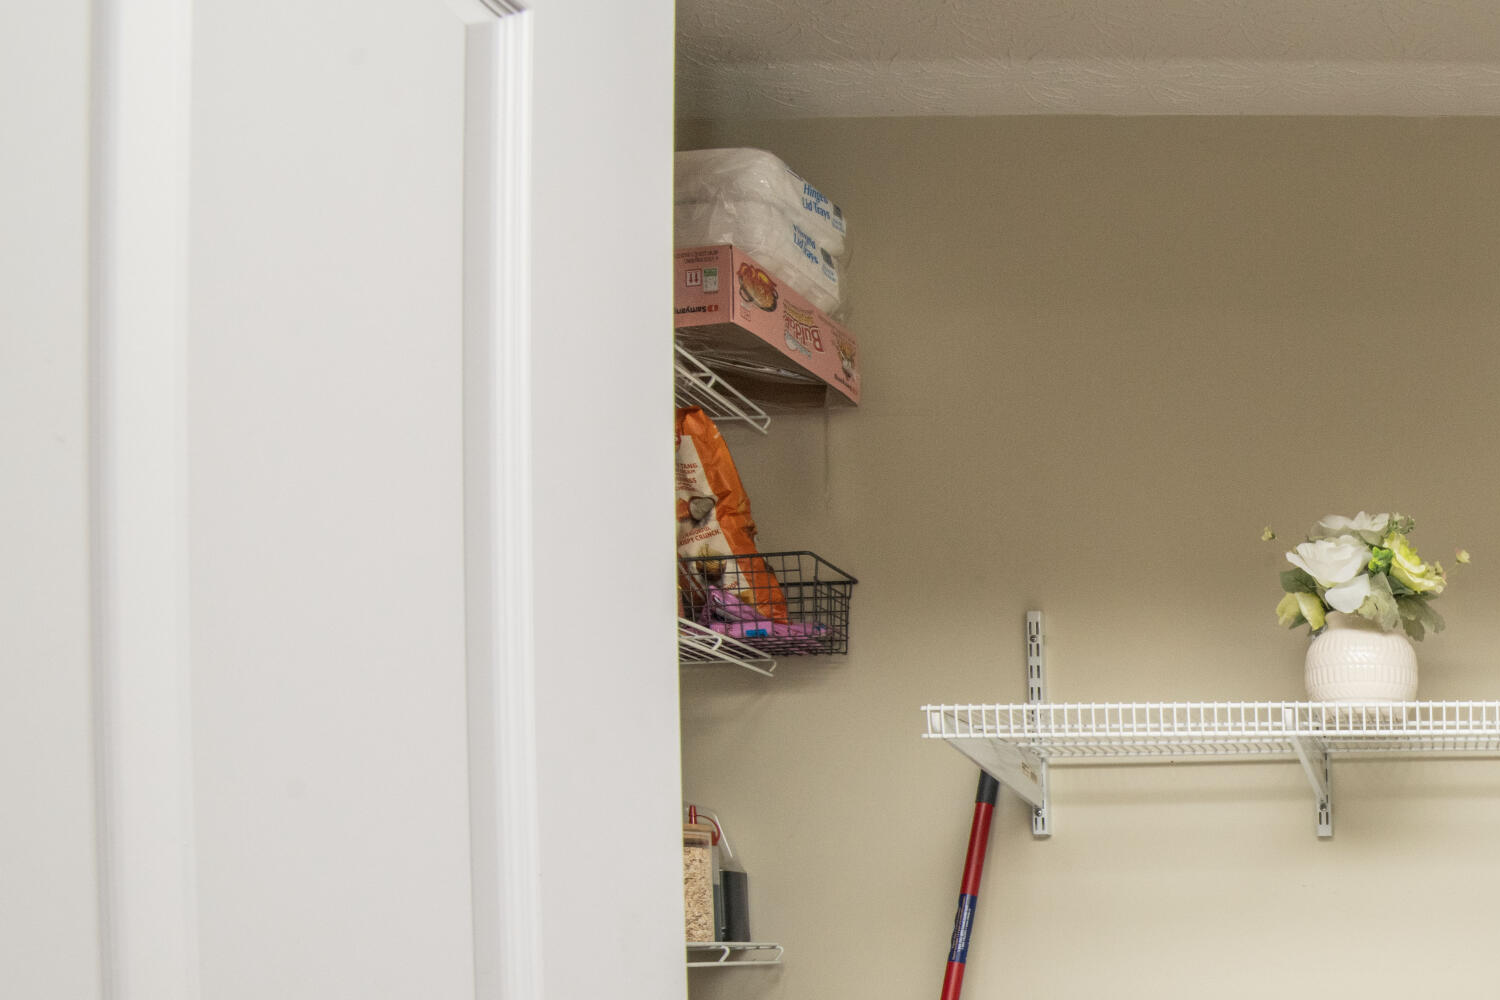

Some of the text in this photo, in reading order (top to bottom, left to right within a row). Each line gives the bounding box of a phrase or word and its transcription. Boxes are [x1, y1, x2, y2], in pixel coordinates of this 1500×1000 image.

[802, 197, 831, 221] Lid Trays
[674, 305, 707, 315] Samyan
